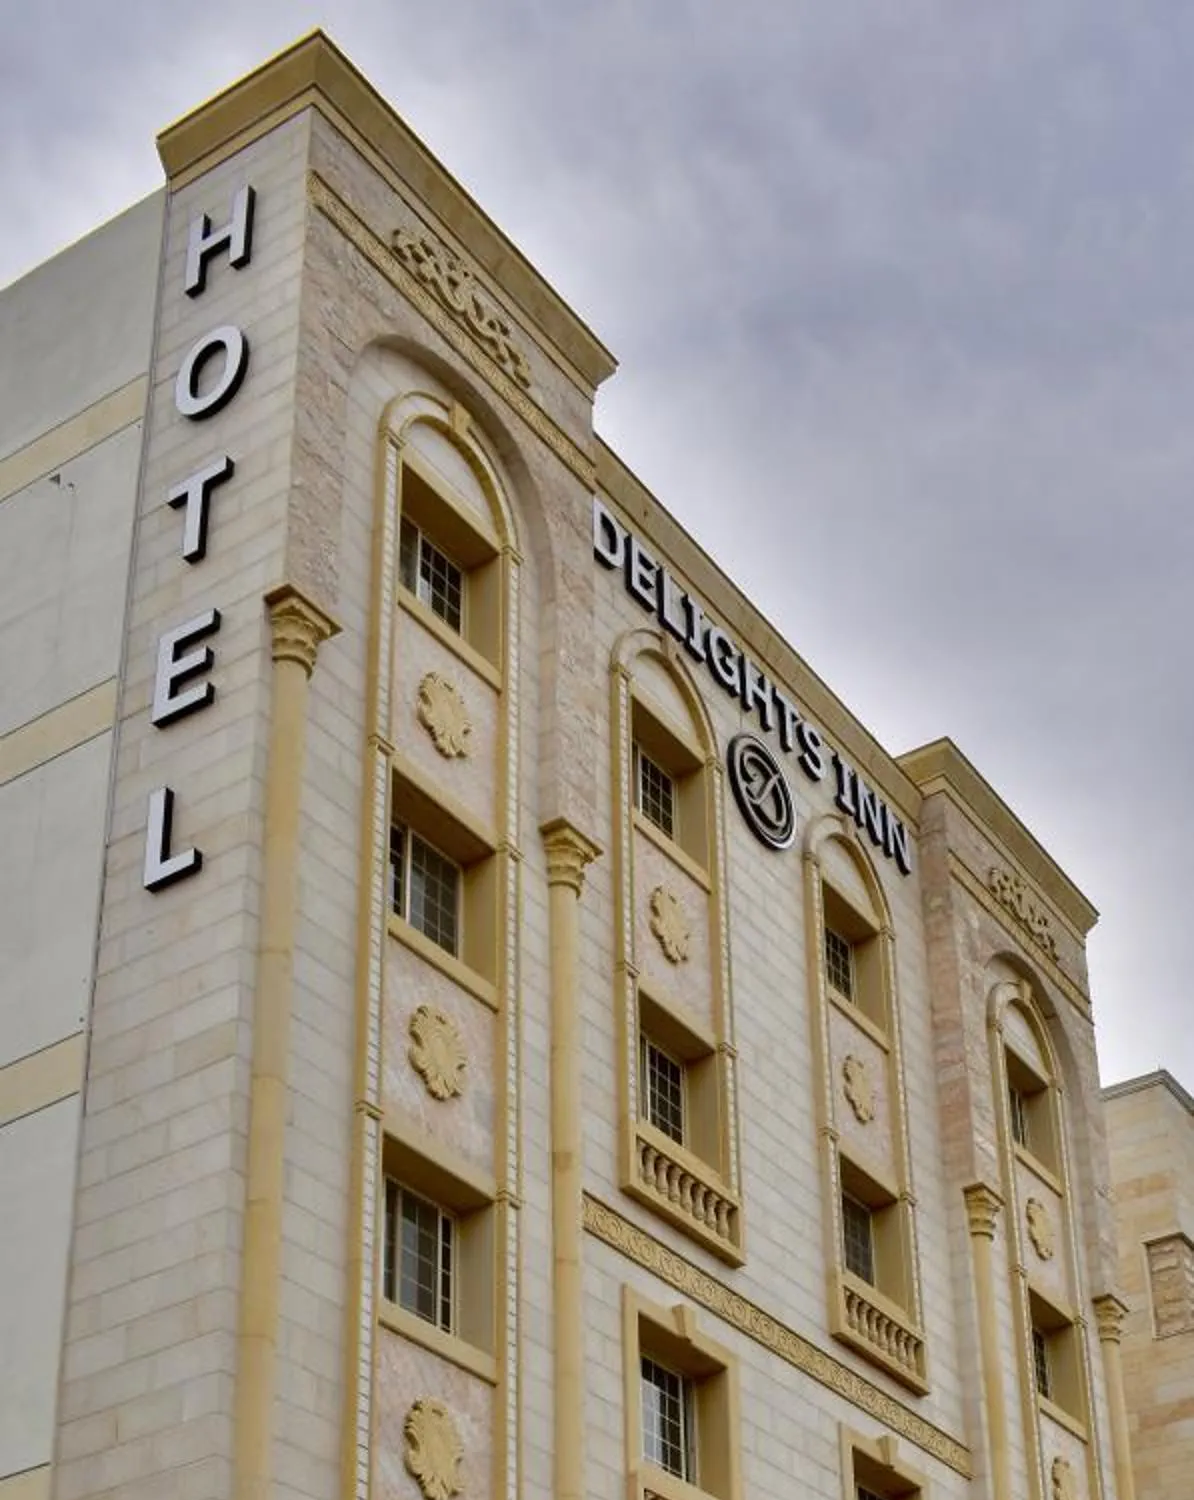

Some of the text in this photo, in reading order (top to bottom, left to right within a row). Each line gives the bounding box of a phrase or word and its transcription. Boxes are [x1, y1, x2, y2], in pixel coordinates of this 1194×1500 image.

[143, 184, 256, 893] HOTEL
[593, 497, 913, 876] DELIGHTS INN
